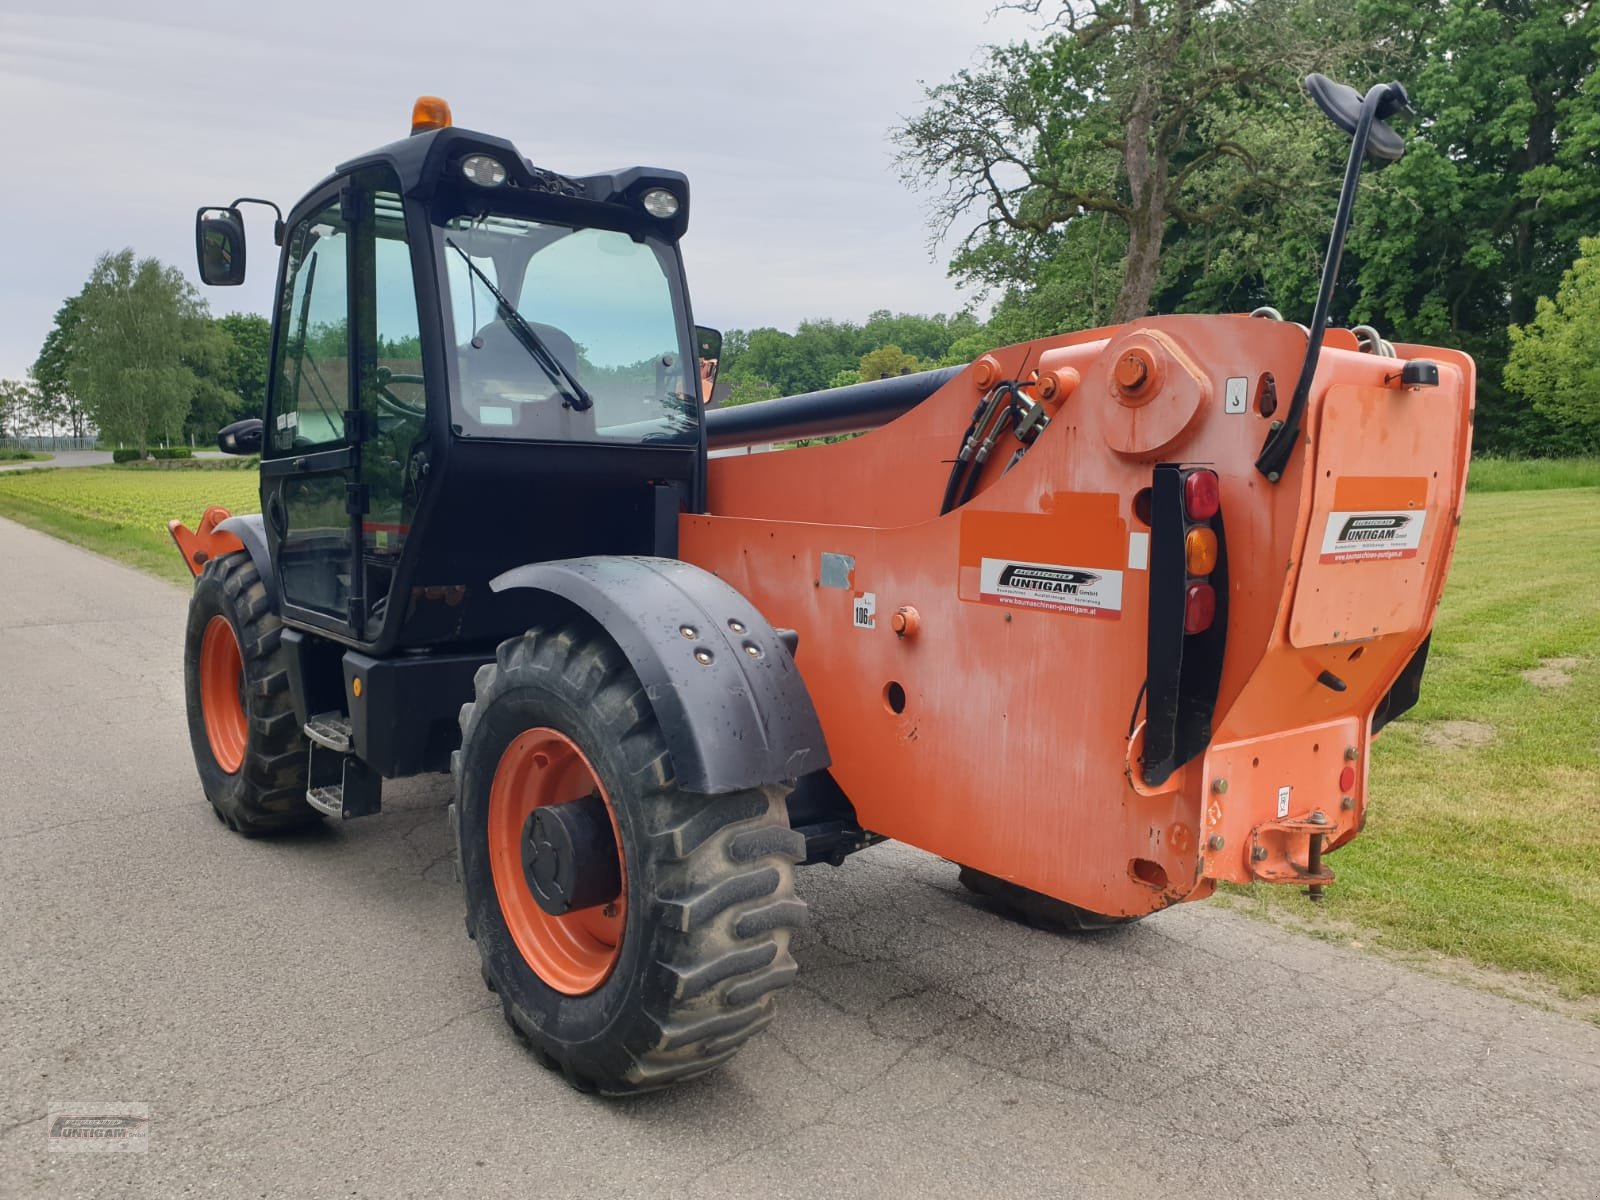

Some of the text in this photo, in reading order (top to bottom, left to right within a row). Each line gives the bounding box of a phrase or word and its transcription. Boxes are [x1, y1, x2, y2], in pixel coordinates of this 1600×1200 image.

[999, 565, 1098, 594] PUNTIGAM
[856, 606, 868, 625] 106
[1000, 598, 1096, 616] www.baumaschinen-puntigam.at
